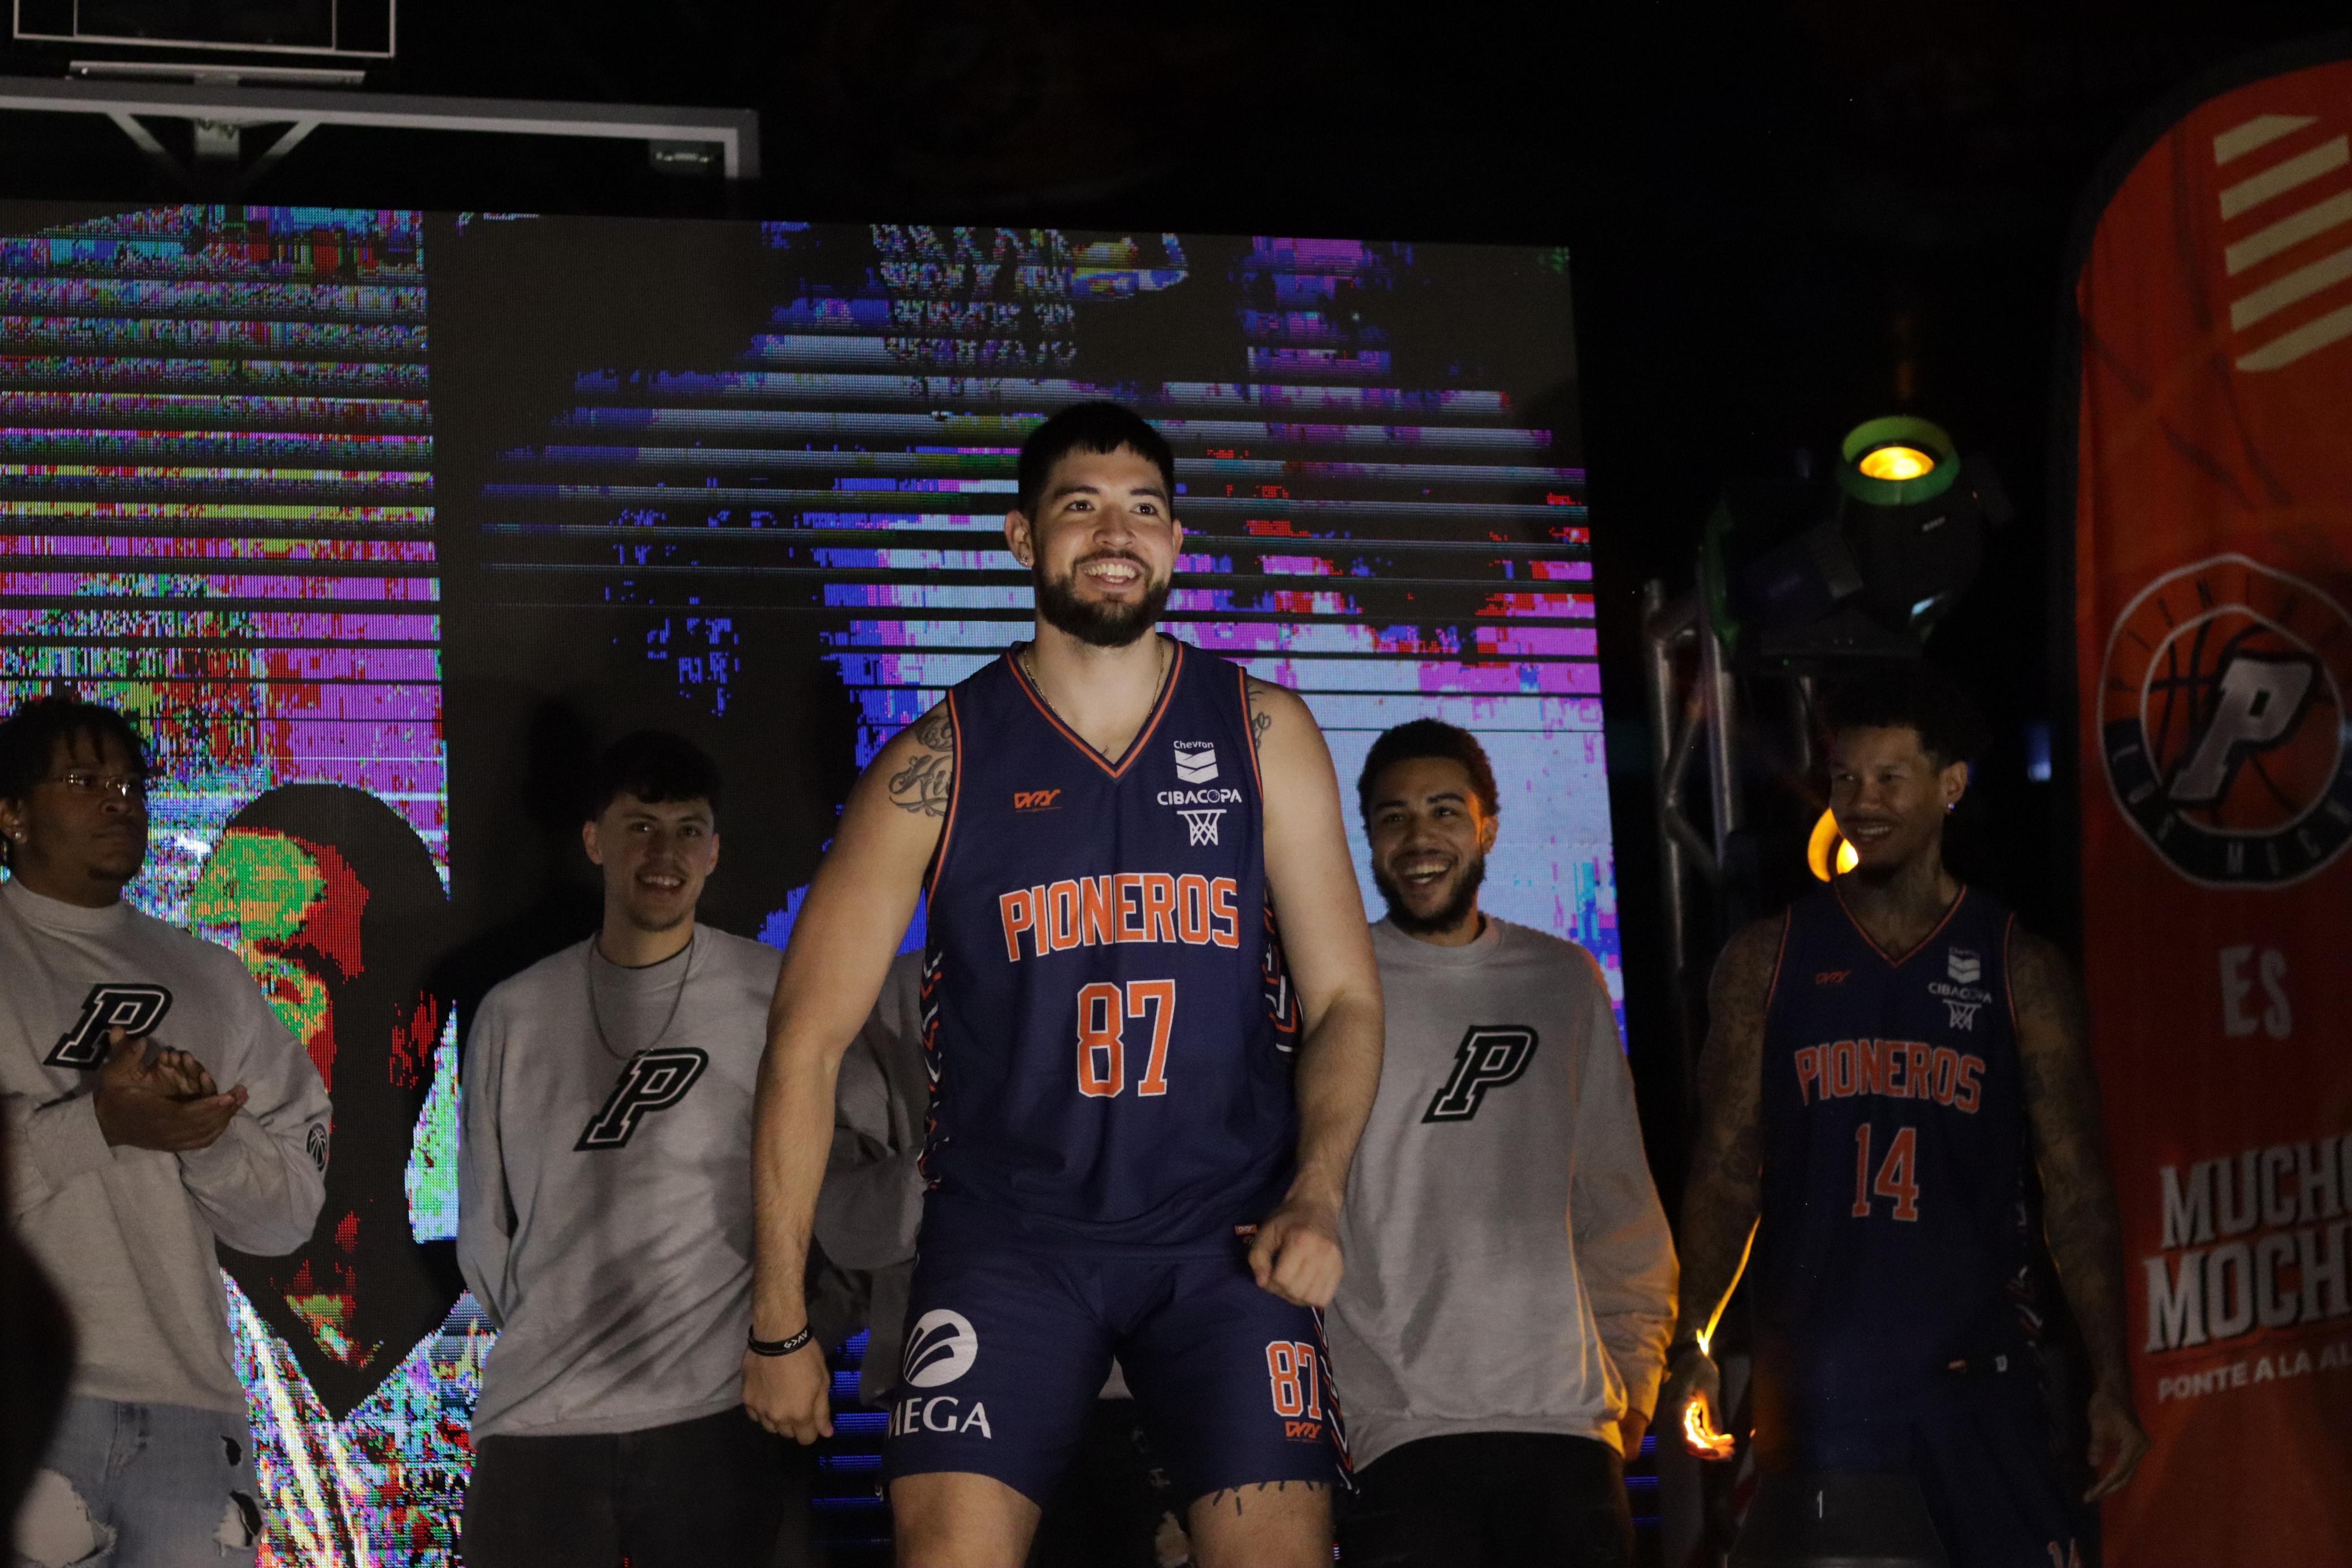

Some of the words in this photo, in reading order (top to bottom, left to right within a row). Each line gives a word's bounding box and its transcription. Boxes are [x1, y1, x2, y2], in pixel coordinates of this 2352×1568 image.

[1173, 740, 1214, 749] Chevron
[1157, 789, 1242, 805] CIBACOPA
[999, 873, 1239, 962] PIONEROS
[2218, 943, 2293, 1041] ES
[1077, 979, 1176, 1098] 87
[1421, 1025, 1539, 1123] P
[1794, 1038, 1986, 1115] PIONEROS
[573, 1047, 709, 1151] P
[1851, 1123, 1920, 1222] 14
[1266, 1341, 1322, 1420] 87
[2157, 1361, 2249, 1403] PONTE
[2252, 1355, 2276, 1384] A
[2278, 1349, 2312, 1379] LA
